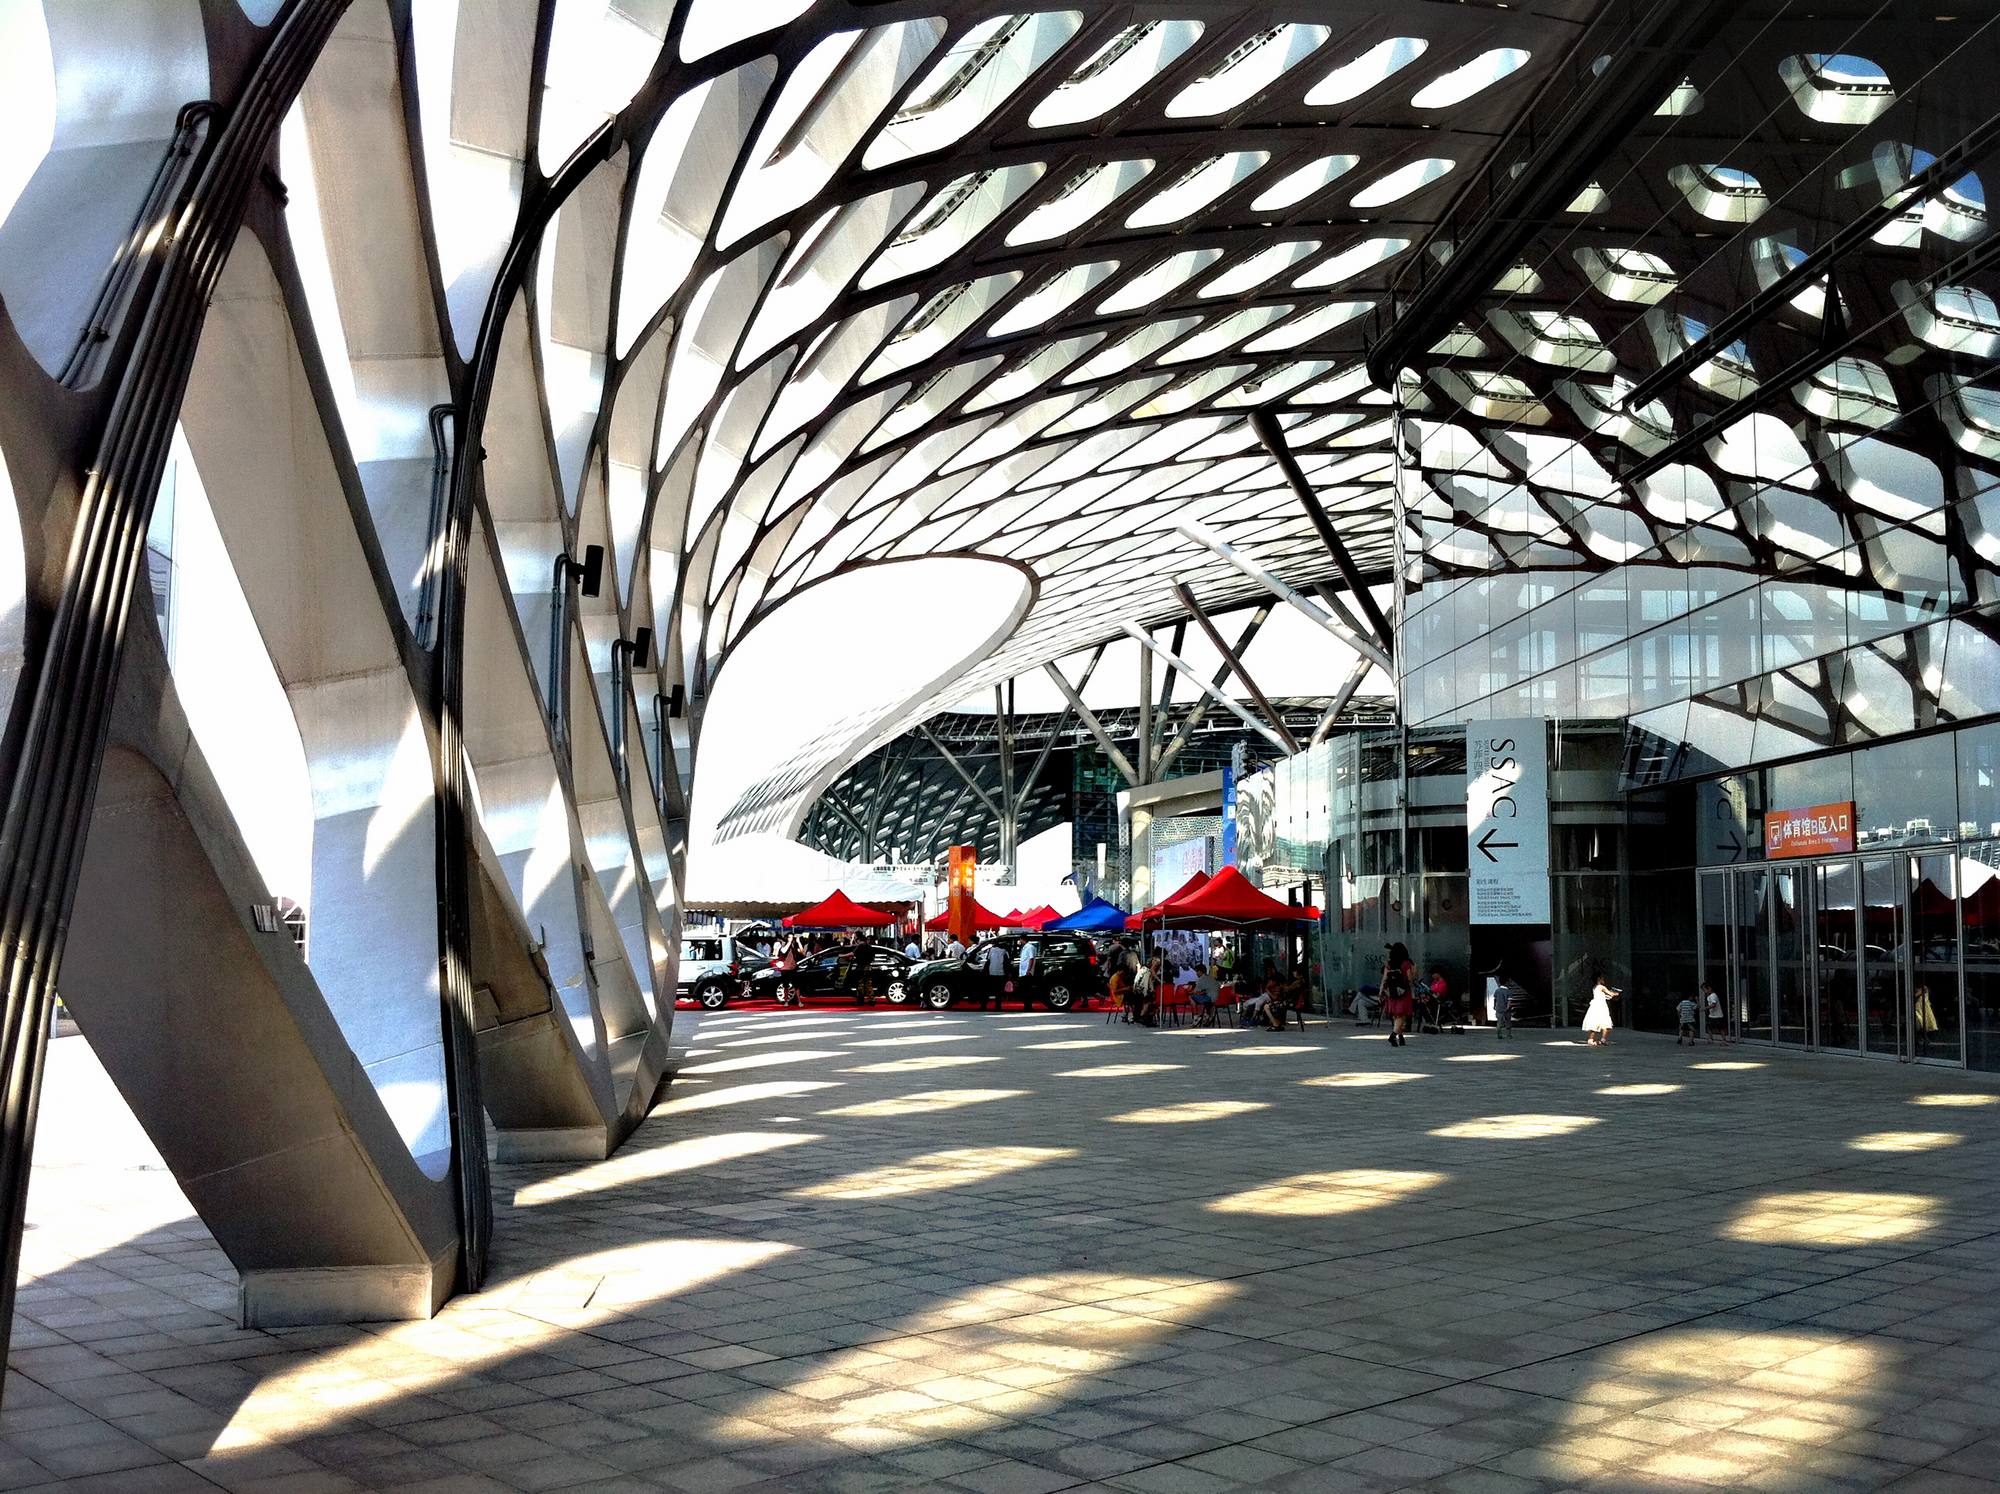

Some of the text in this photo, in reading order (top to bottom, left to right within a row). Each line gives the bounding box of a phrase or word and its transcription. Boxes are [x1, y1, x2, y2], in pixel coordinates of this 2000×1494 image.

[1490, 738, 1517, 818] SSAC
[1783, 814, 1848, 839] 体育馆B区入口
